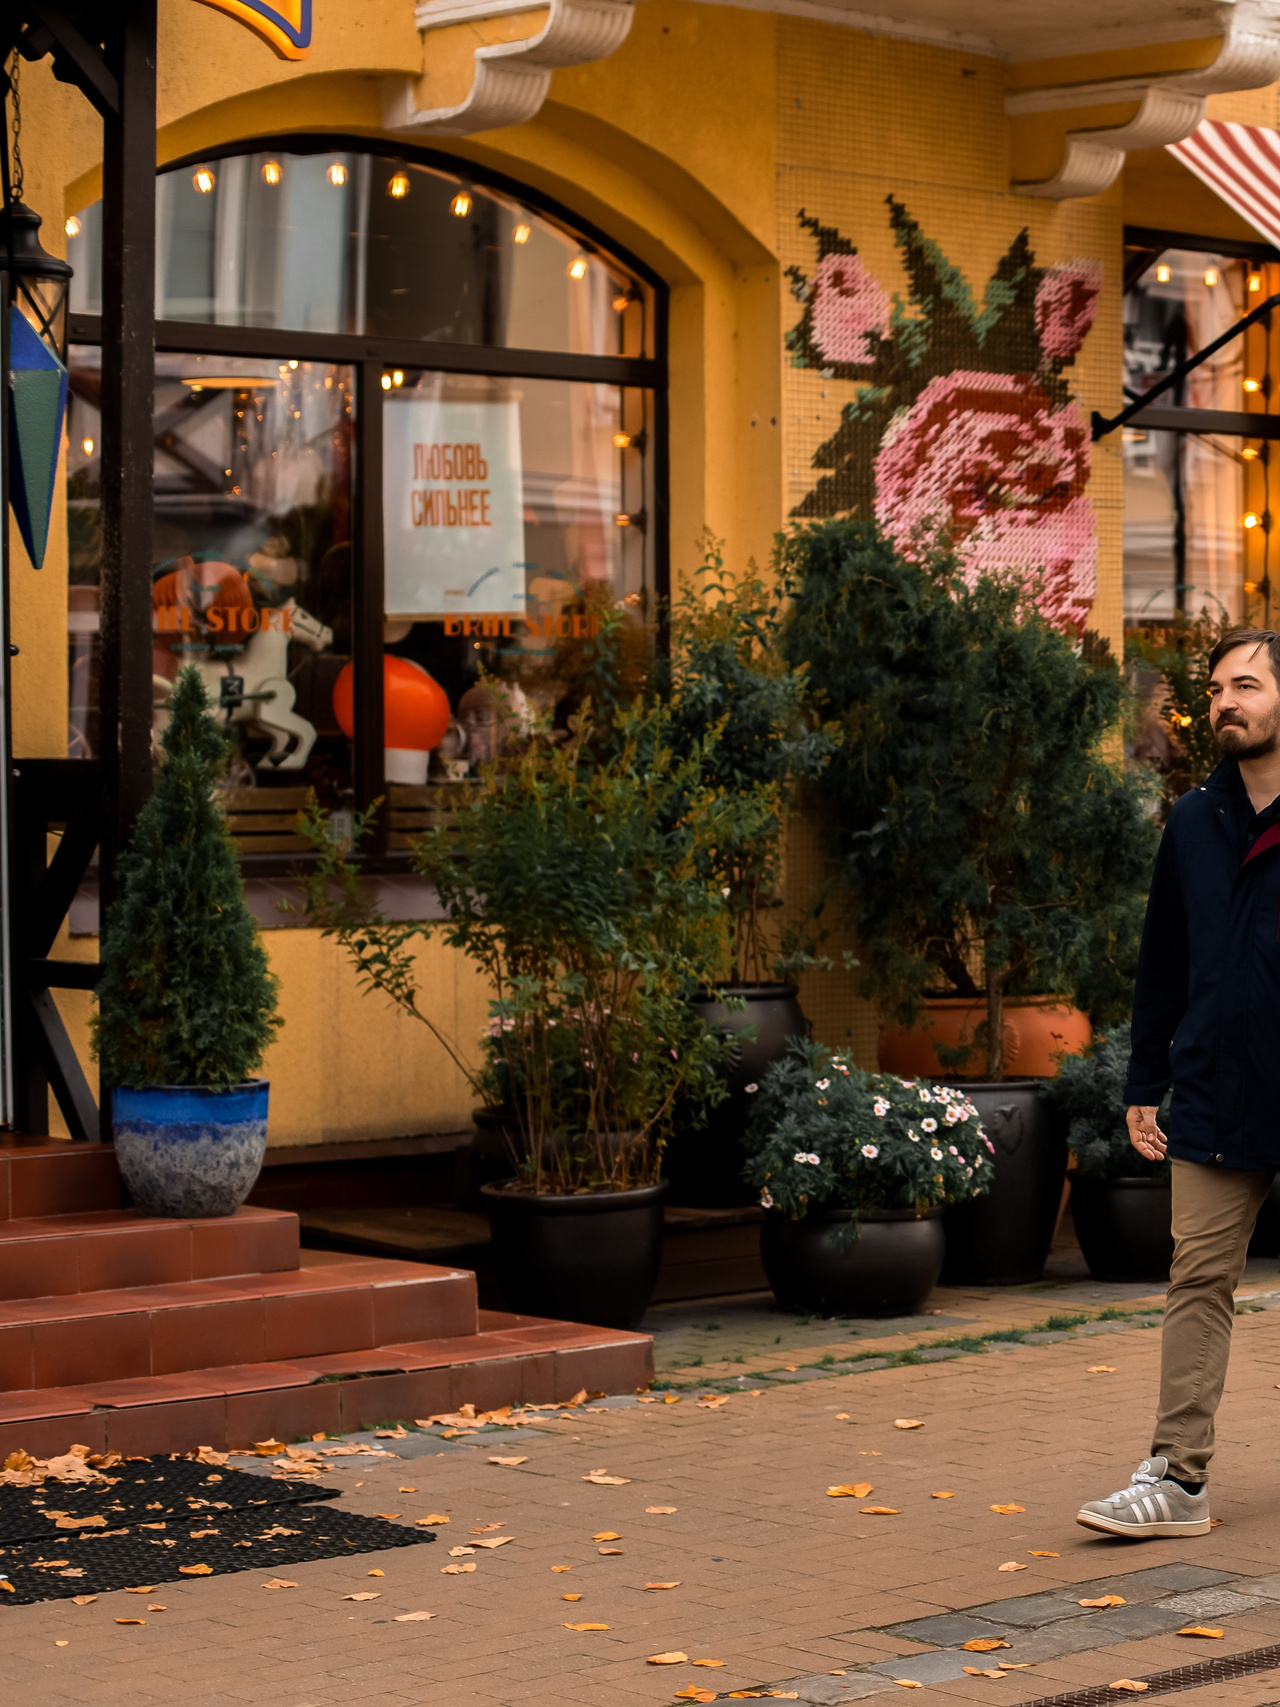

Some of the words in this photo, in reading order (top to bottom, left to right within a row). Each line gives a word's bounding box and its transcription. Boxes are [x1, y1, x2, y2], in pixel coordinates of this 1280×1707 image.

[413, 442, 489, 482] ЛЮБОВЬ
[410, 488, 493, 528] СИЛЬНЕЕ
[205, 605, 294, 633] STORE
